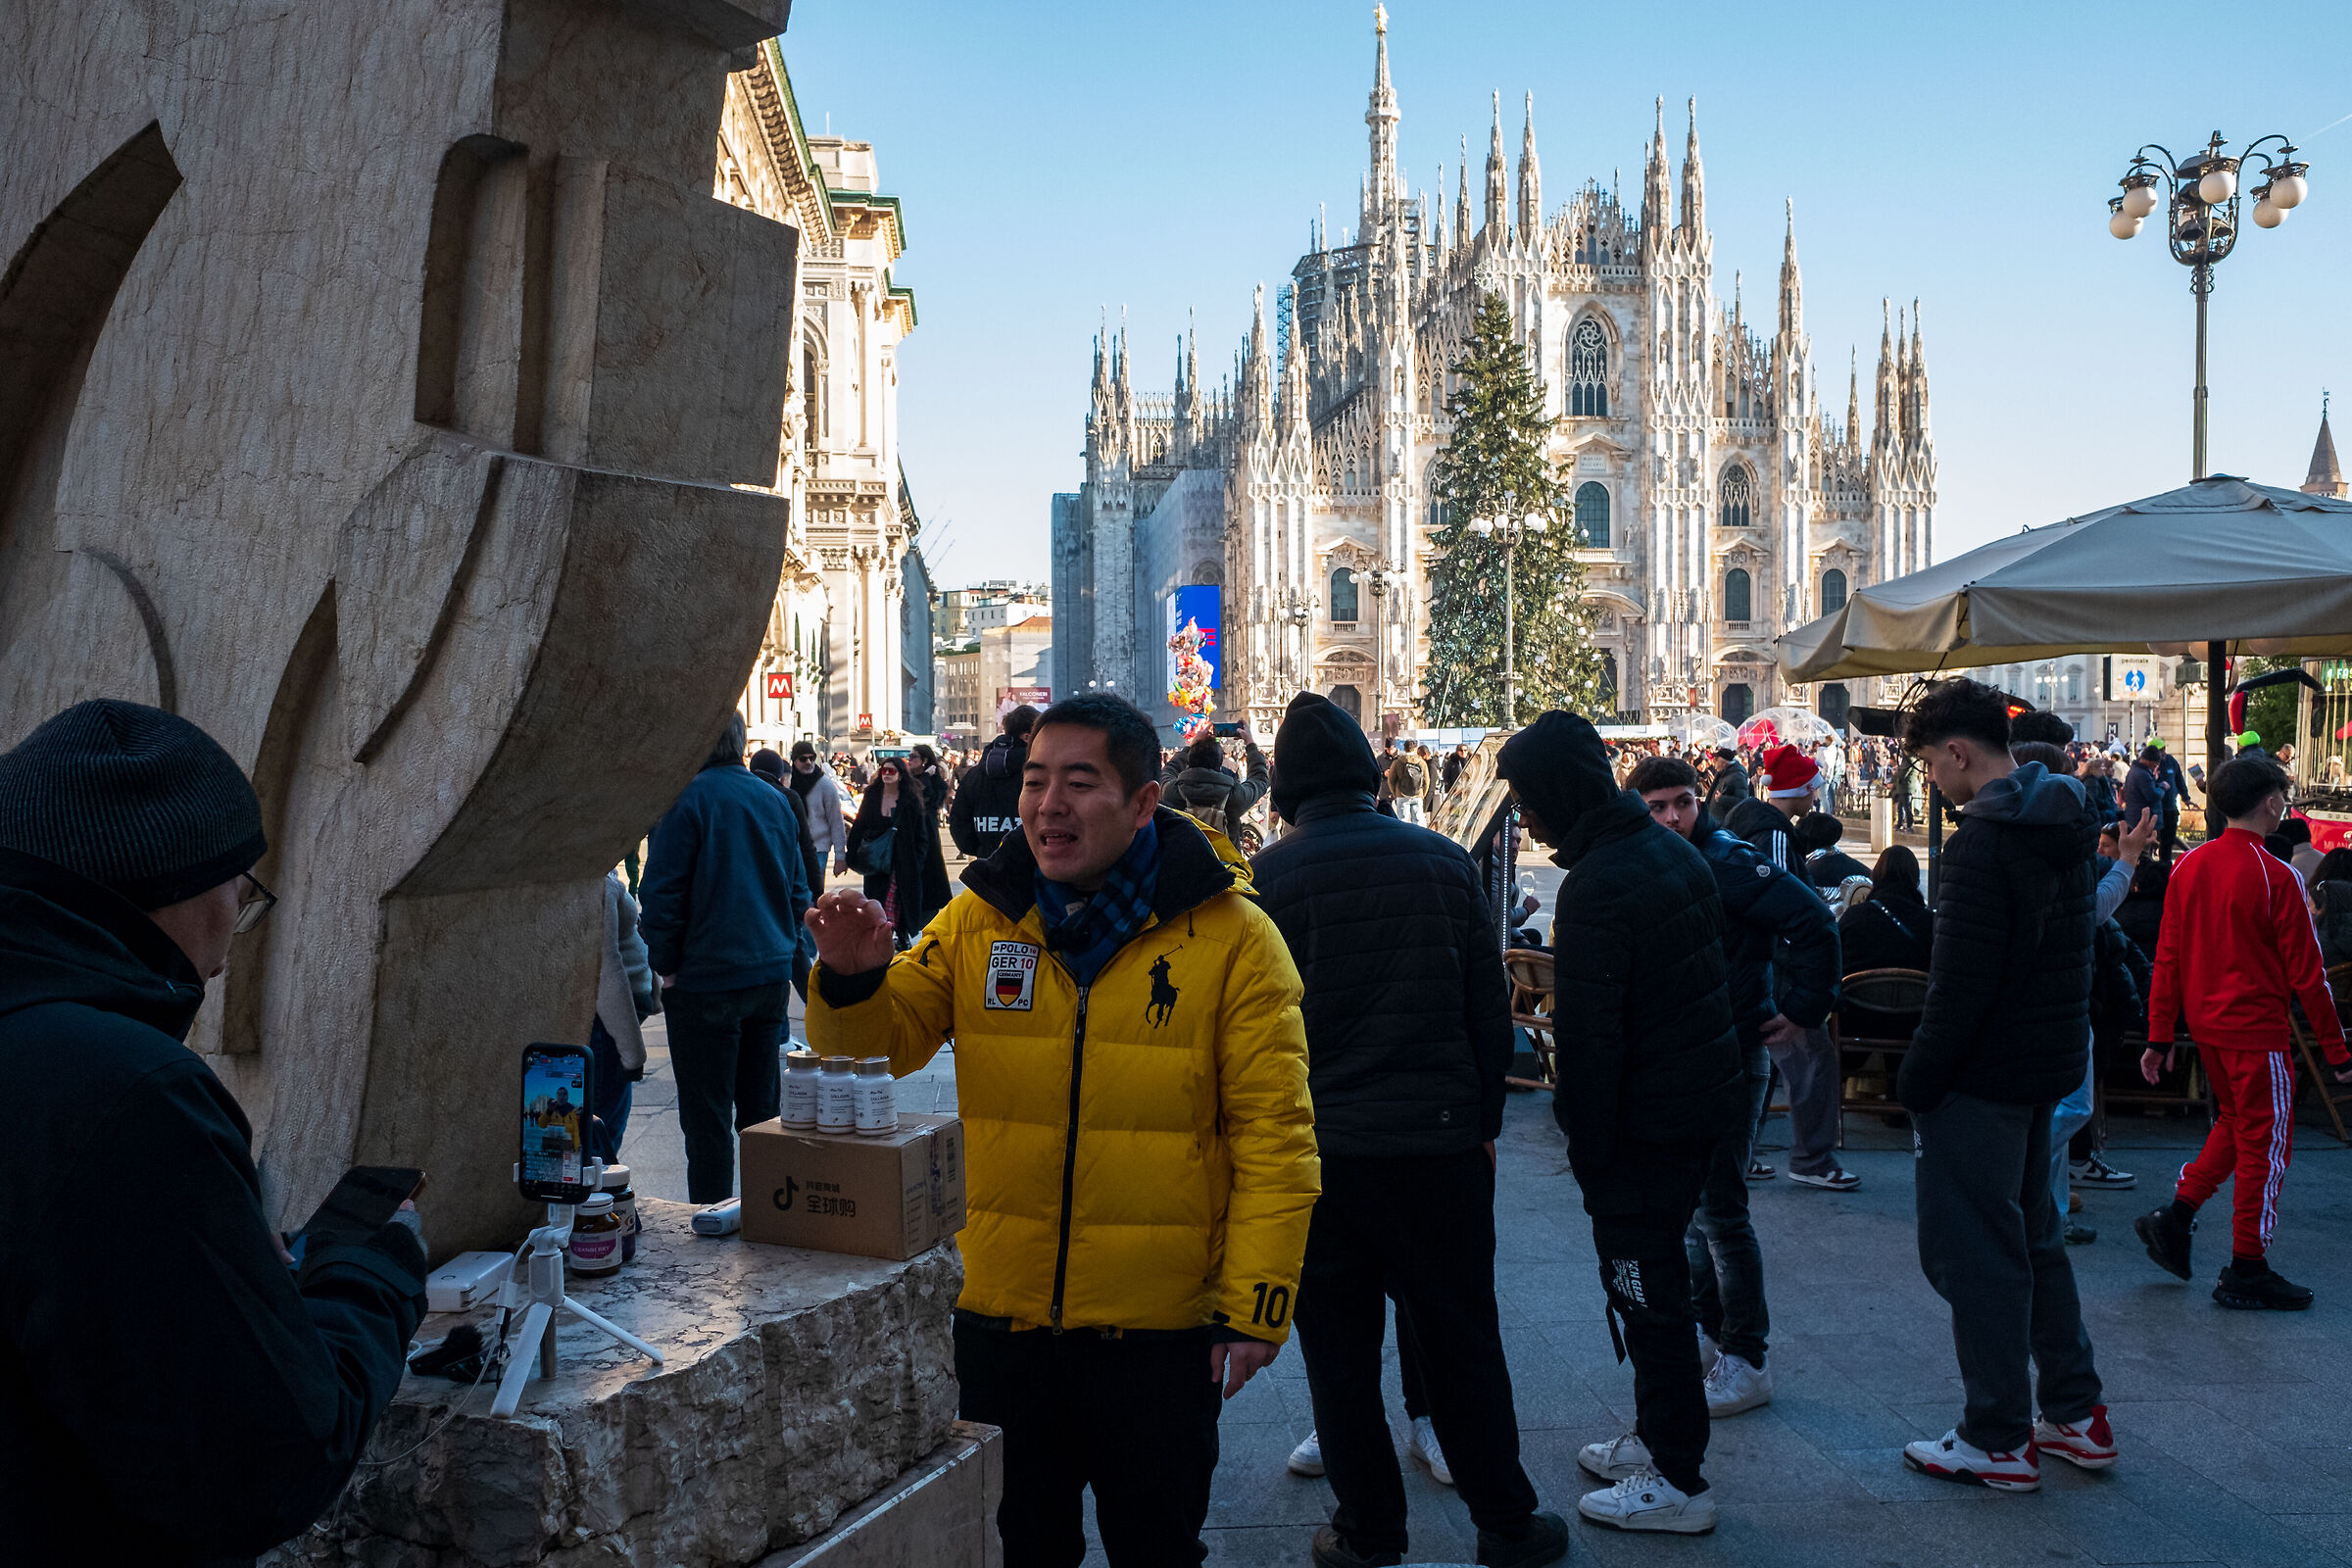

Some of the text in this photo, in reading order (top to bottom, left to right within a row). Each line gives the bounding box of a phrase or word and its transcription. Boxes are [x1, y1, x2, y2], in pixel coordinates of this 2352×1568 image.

[769, 677, 792, 694] M
[859, 716, 871, 725] M
[973, 816, 1023, 832] HEA
[1001, 944, 1029, 955] POLO
[992, 956, 1034, 969] GER 10
[807, 1195, 856, 1217] 全球购
[1631, 1279, 1645, 1303] GEAR
[1252, 1281, 1290, 1329] 10
